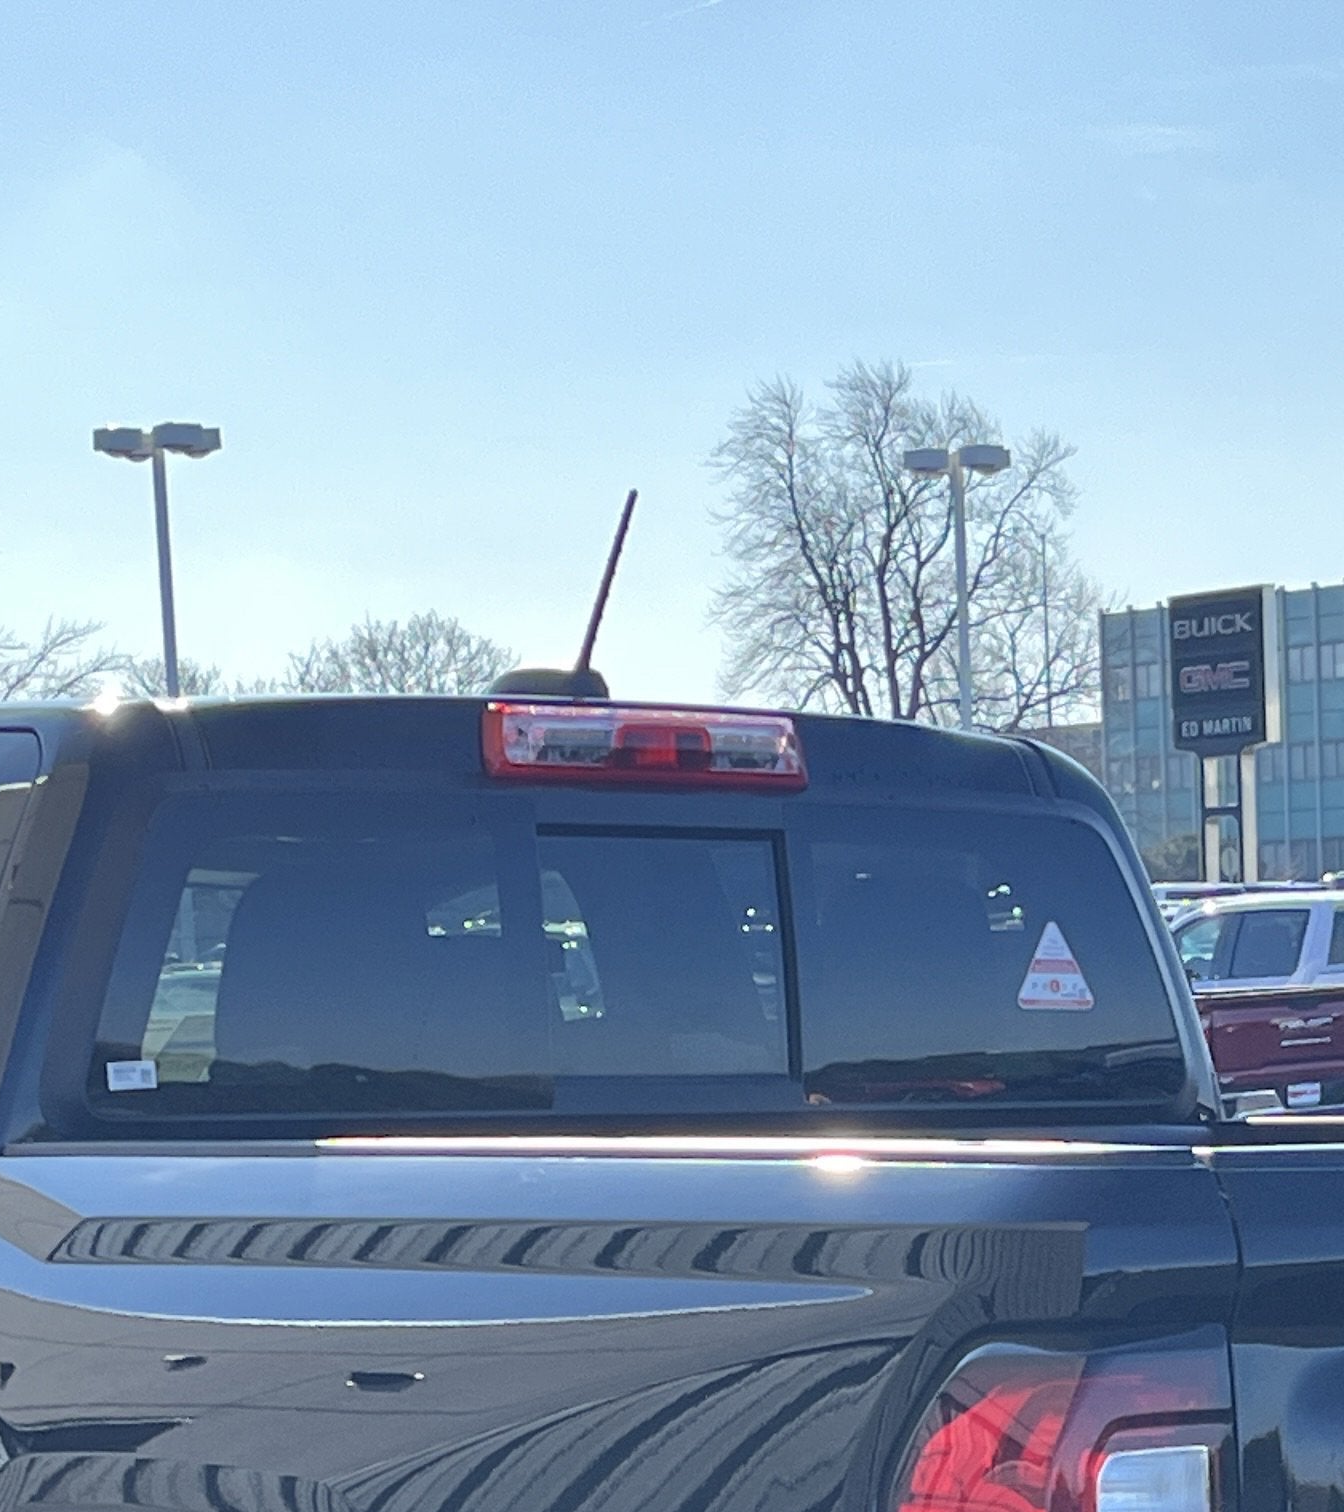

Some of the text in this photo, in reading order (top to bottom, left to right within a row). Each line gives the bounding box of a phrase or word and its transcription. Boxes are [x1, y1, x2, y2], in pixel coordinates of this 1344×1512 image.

[1173, 611, 1253, 640] BUICK
[1179, 660, 1250, 694] GMC
[1181, 715, 1253, 738] ED MARTIN
